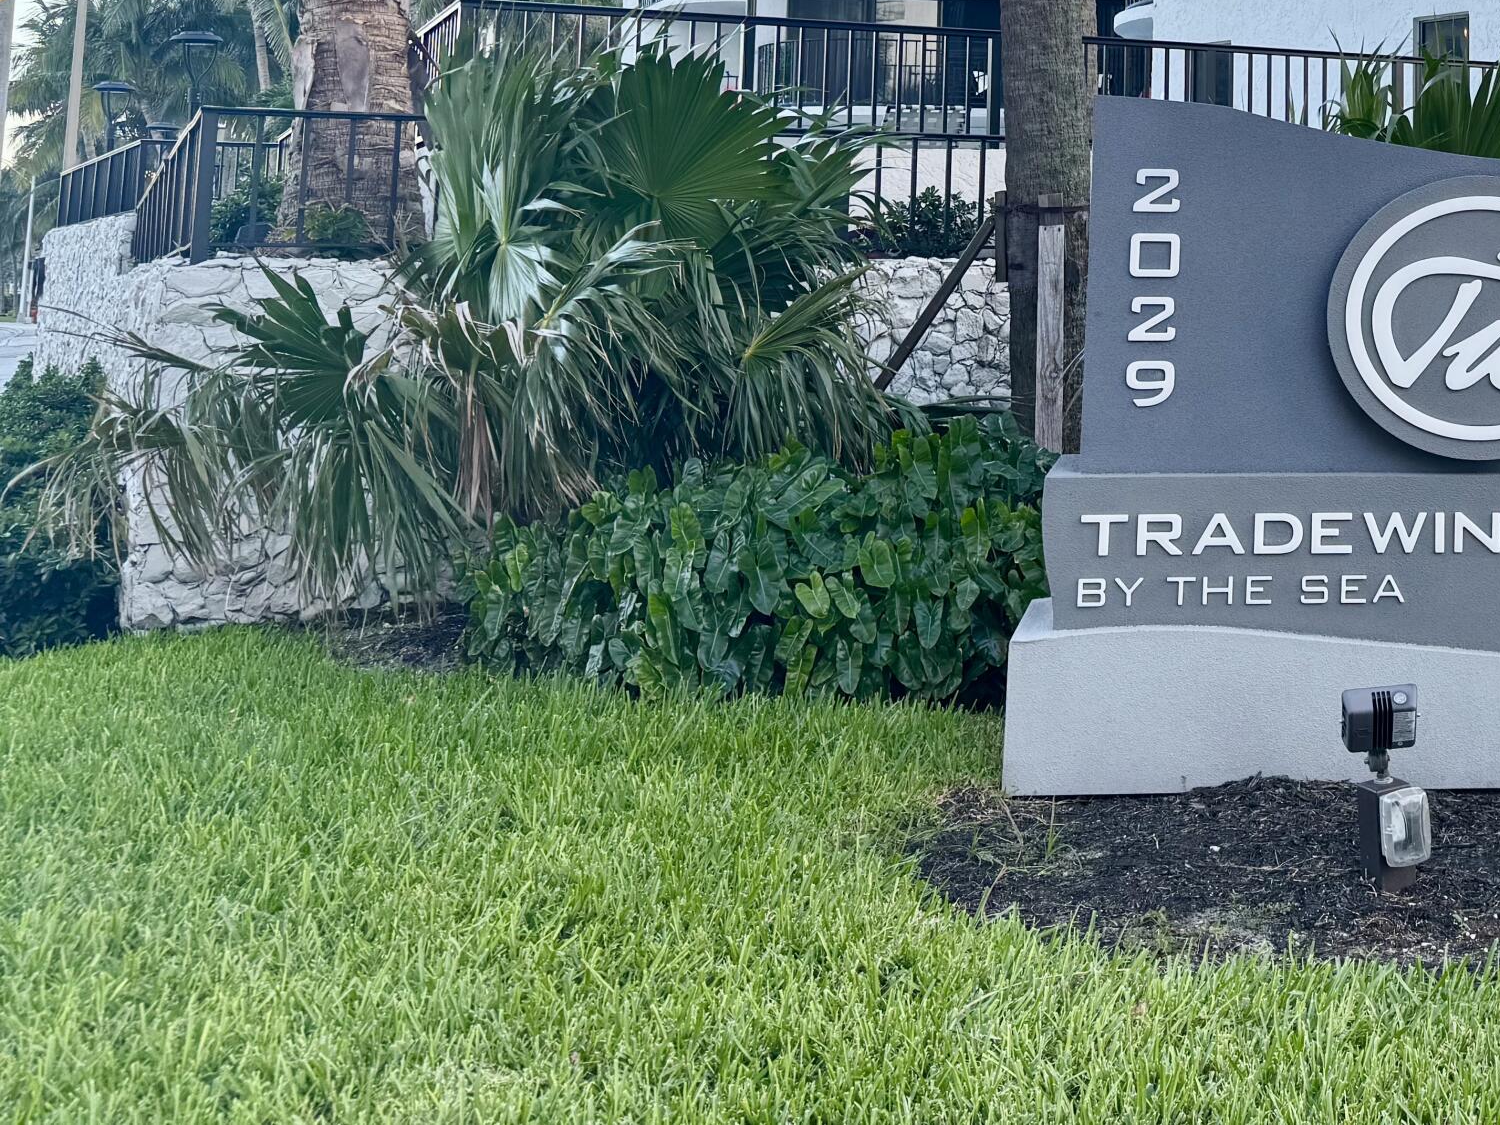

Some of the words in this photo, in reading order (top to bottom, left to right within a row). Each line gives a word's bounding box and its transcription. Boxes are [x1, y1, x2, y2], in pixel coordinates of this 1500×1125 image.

[1126, 168, 1181, 407] 2029
[1076, 577, 1145, 607] BY
[1166, 575, 1273, 606] THE
[1300, 574, 1405, 604] SEA
